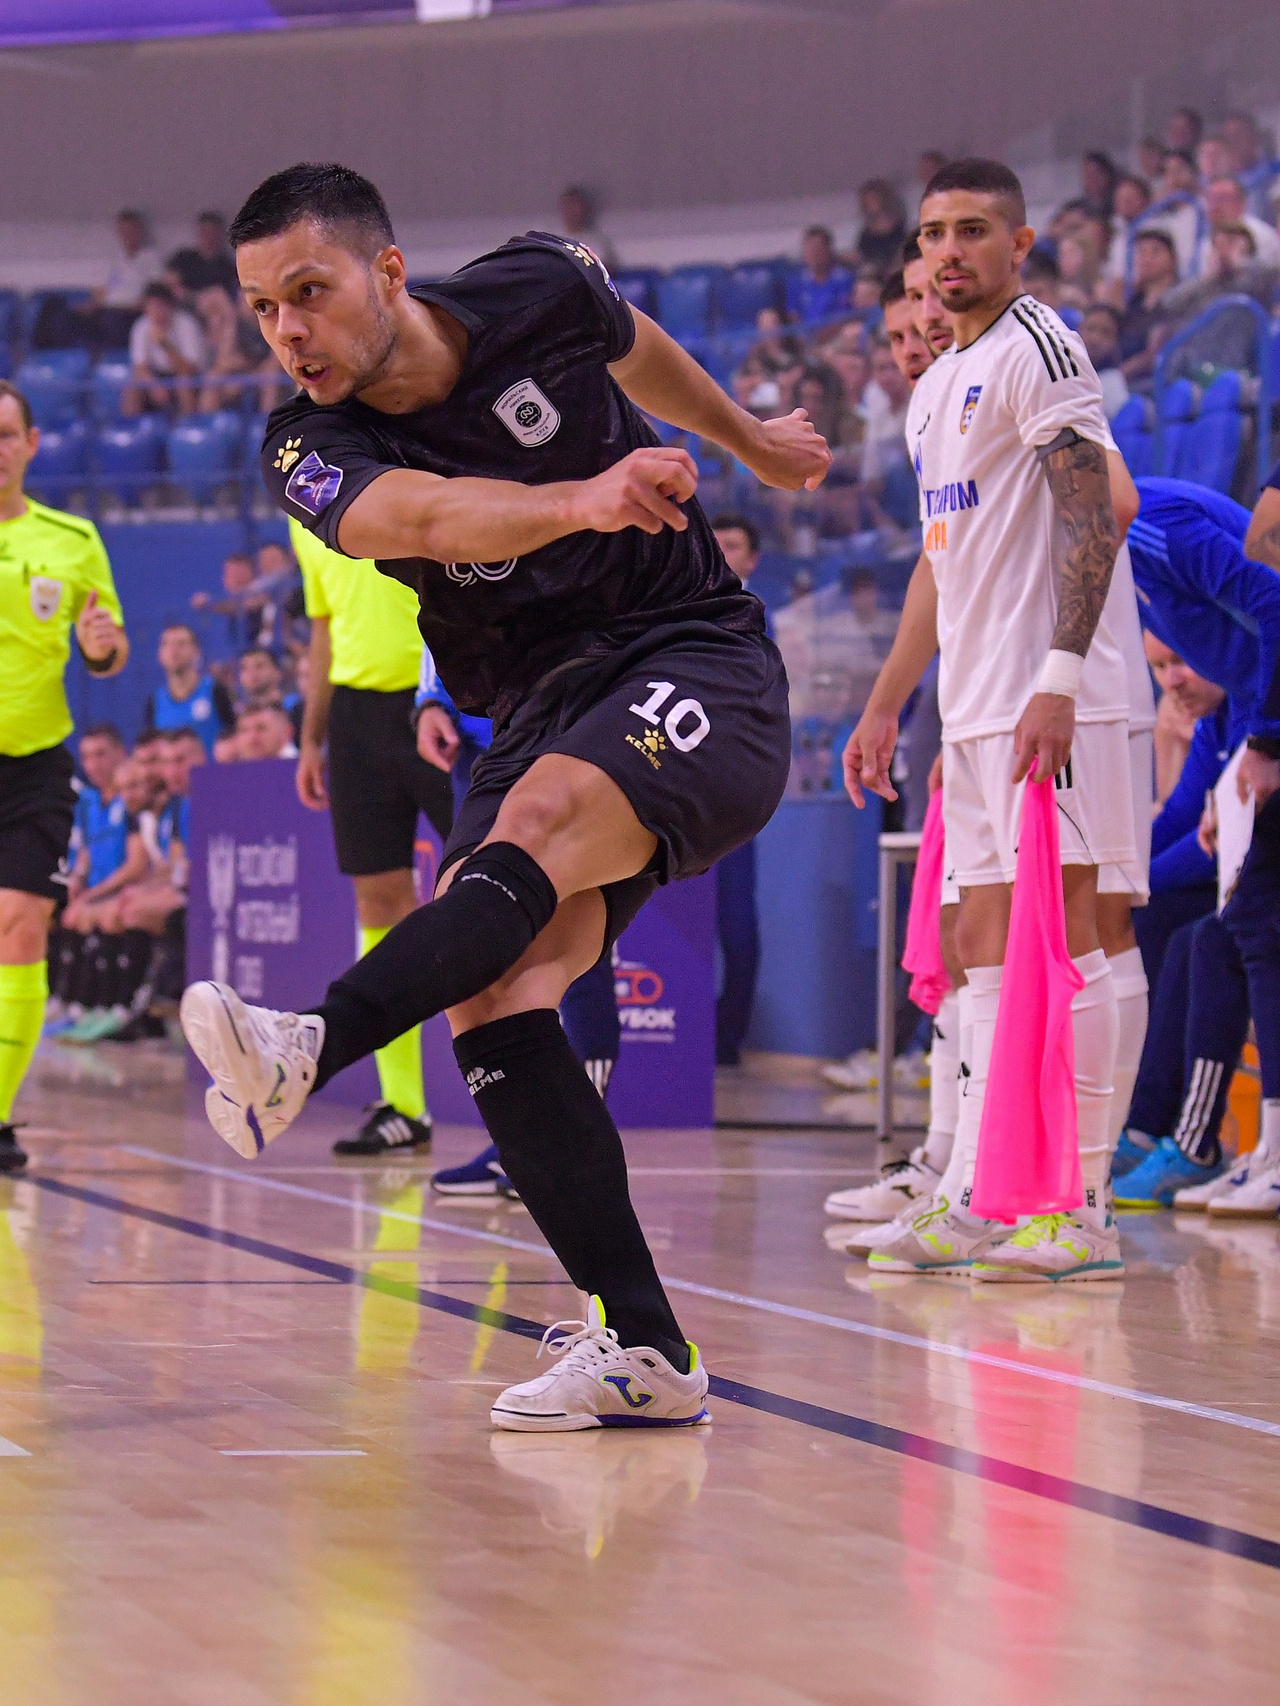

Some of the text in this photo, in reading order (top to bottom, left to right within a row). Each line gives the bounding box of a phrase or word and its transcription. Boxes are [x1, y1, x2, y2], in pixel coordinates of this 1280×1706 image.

[628, 681, 711, 753] 10
[625, 733, 662, 770] KELME
[469, 1069, 506, 1096] ELME
